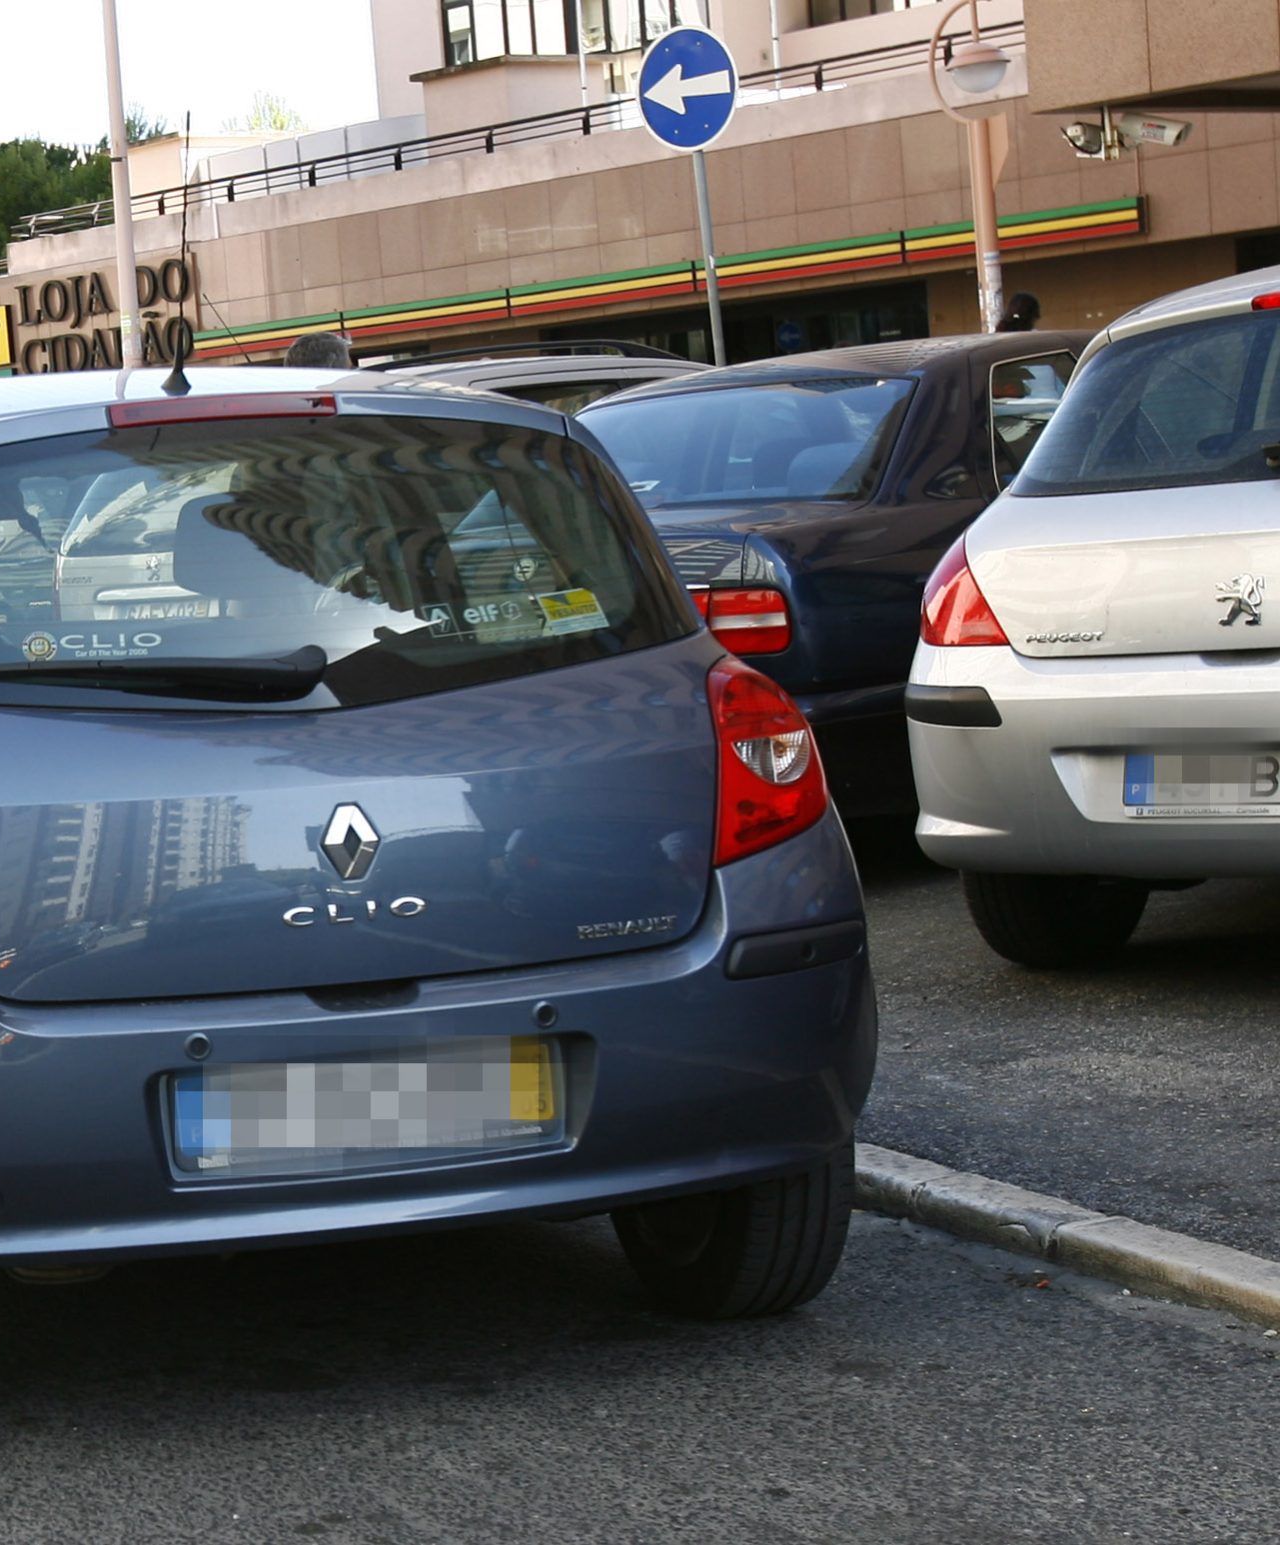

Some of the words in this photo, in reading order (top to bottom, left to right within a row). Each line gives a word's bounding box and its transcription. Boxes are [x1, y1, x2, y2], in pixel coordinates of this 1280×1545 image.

[15, 272, 114, 329] LOJA
[135, 259, 190, 307] DO
[463, 603, 499, 624] elf
[60, 632, 162, 648] CLIO
[1025, 631, 1104, 643] PEUGEOT
[282, 896, 426, 926] CLIO
[576, 914, 678, 940] RENAULT
